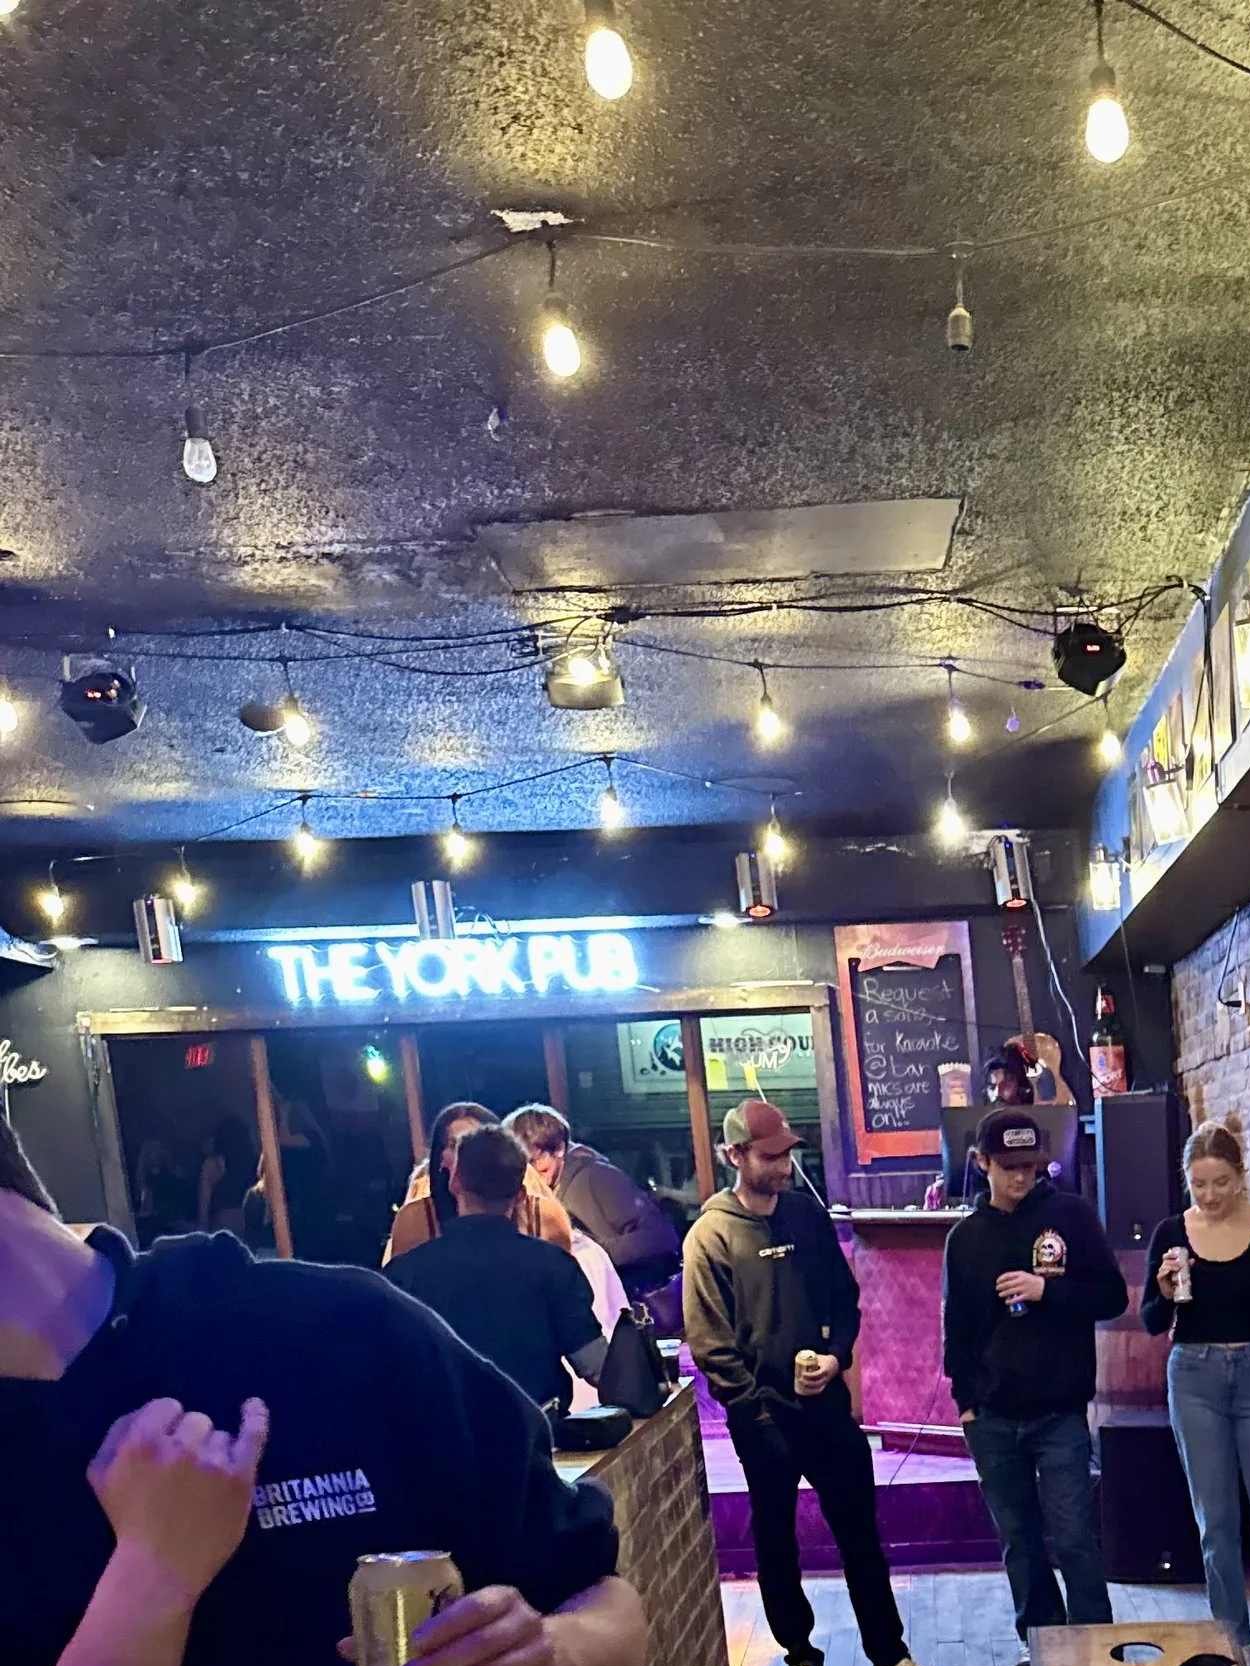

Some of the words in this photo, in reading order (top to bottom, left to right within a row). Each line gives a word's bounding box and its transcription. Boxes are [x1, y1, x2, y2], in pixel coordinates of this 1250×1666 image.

[267, 944, 380, 999] THE
[375, 938, 525, 998] YORK
[527, 932, 640, 992] PUB
[860, 942, 946, 960] Budweiser
[863, 977, 954, 1008] Request
[865, 1009, 879, 1024] a
[904, 1081, 931, 1094] are
[254, 1468, 371, 1507] BRITANNIA
[257, 1494, 357, 1529] BREWING
